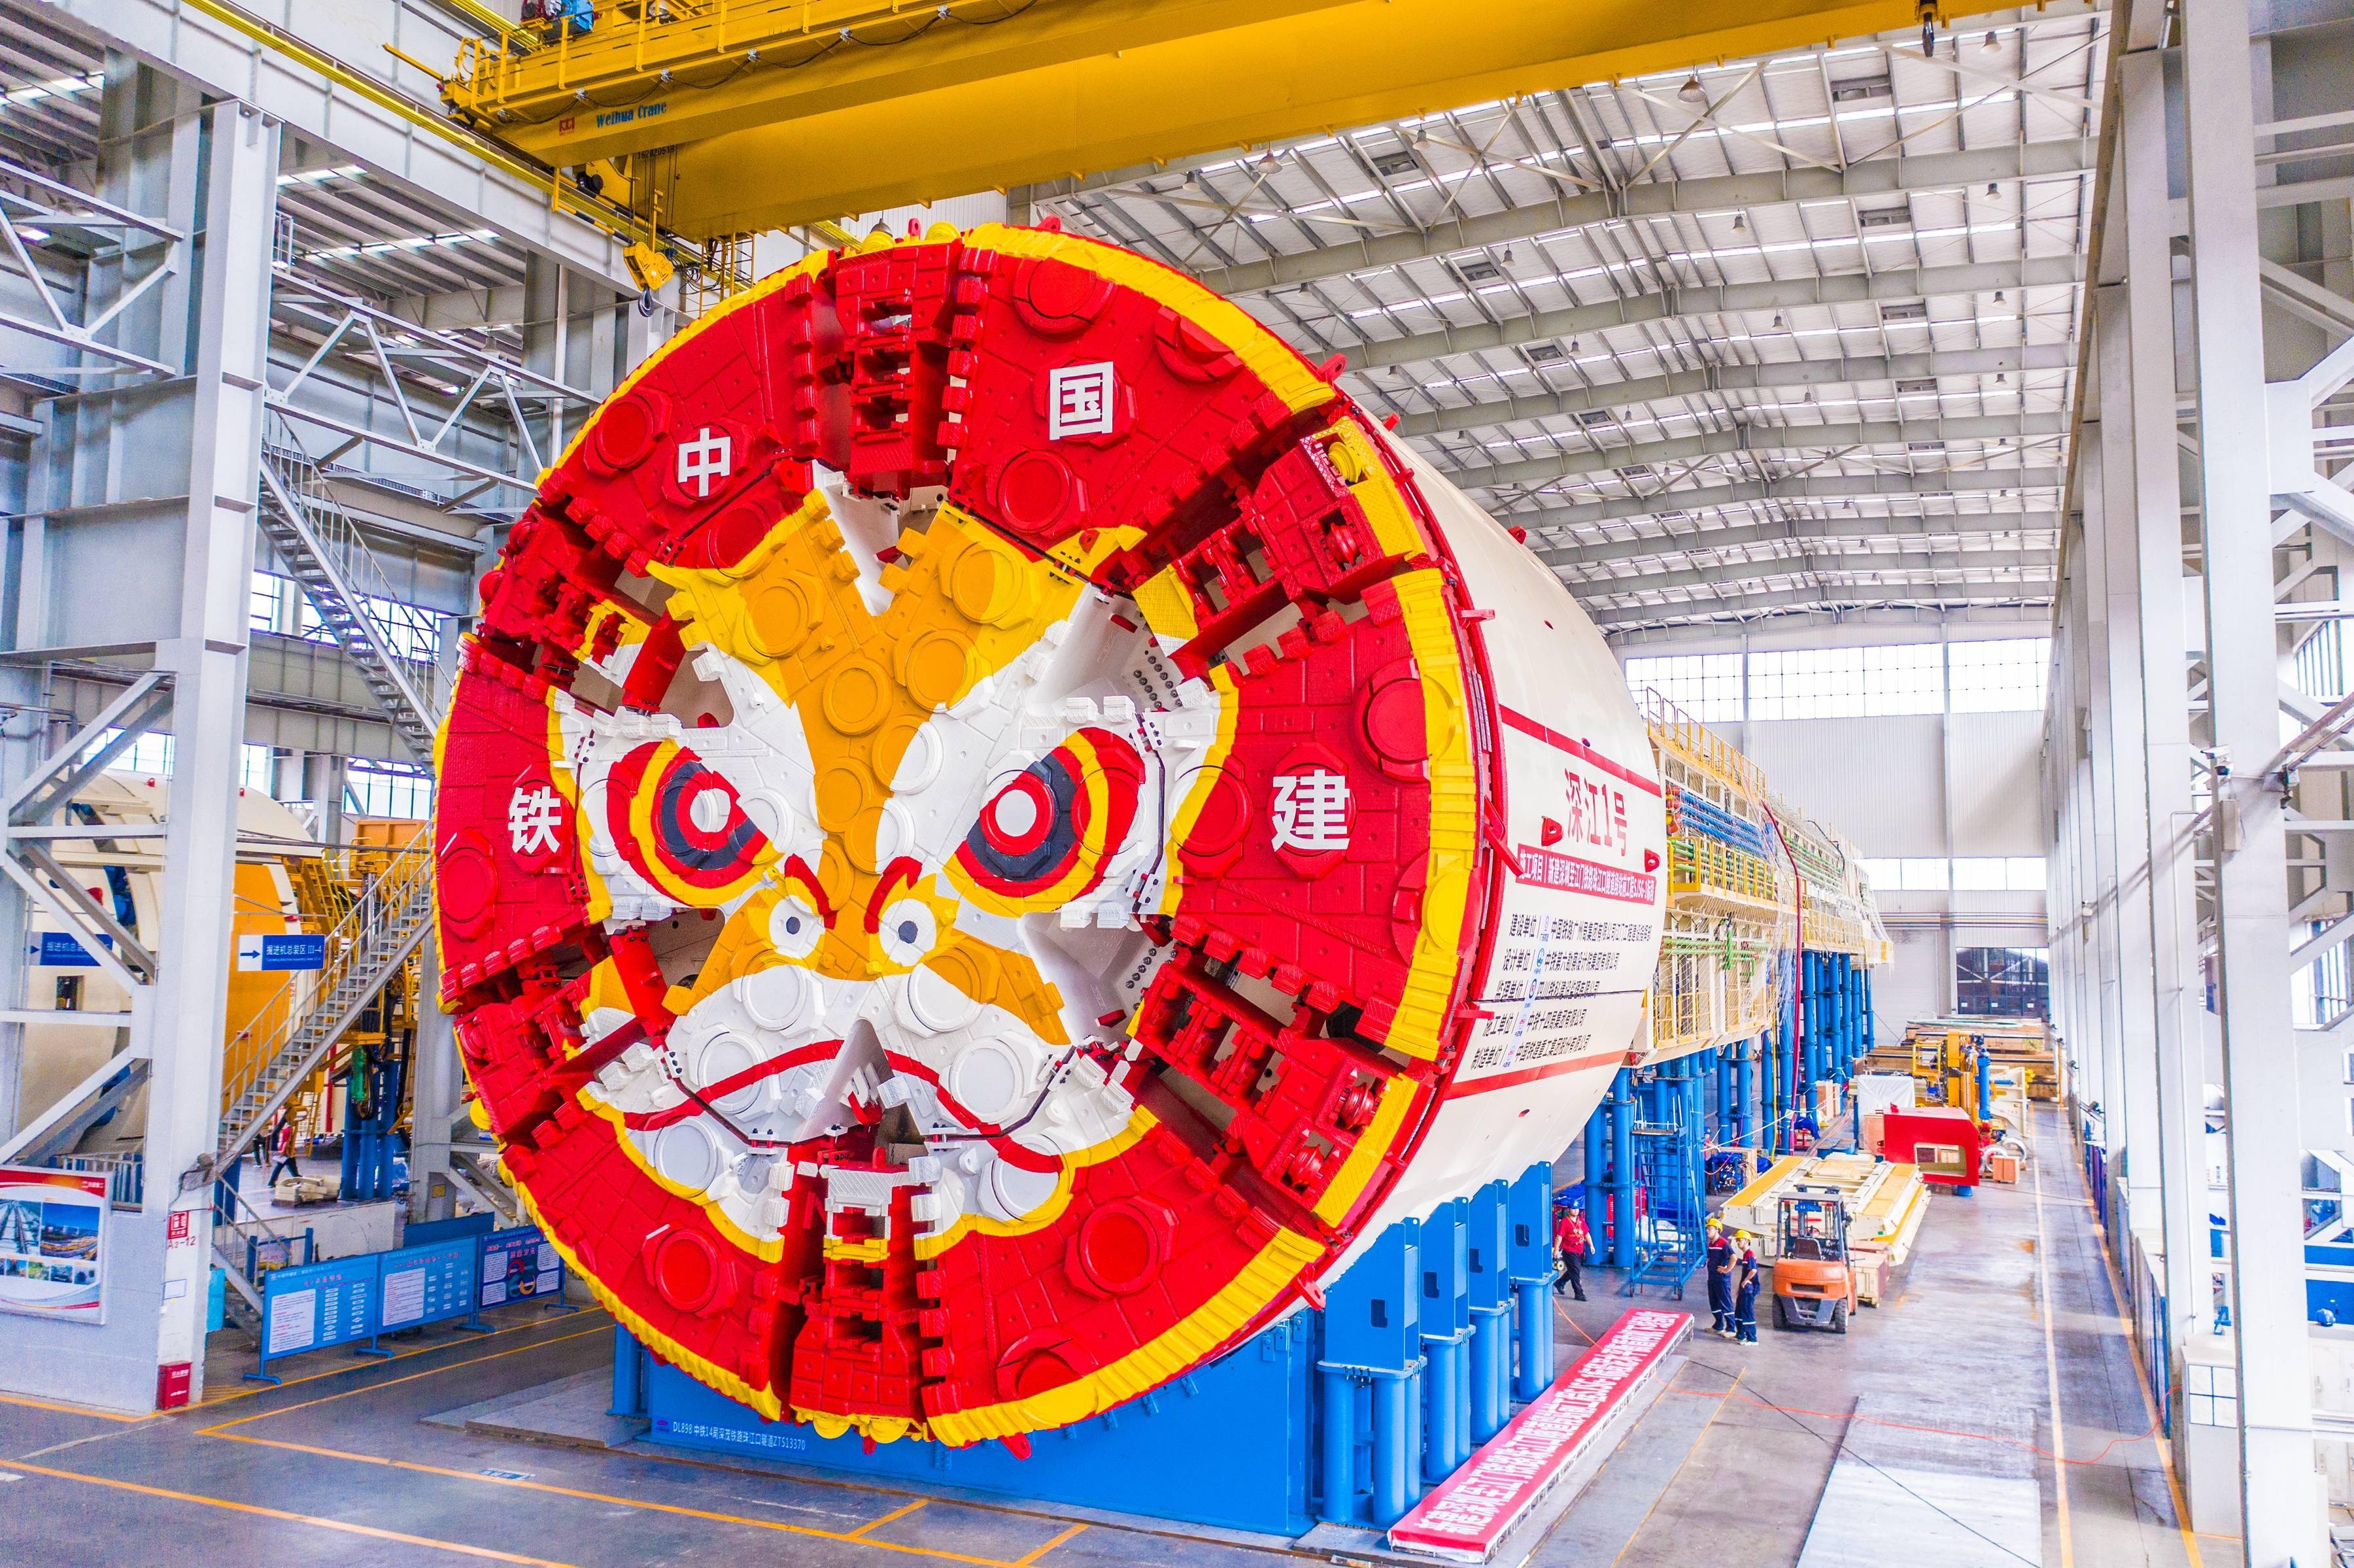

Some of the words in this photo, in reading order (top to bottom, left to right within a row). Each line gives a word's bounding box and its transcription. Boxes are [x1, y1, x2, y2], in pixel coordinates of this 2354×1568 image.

[596, 108, 634, 128] Weihua
[638, 101, 667, 119] Crane
[1049, 361, 1114, 440] 国
[678, 428, 730, 497] 中
[508, 786, 562, 854] 铁
[1271, 770, 1350, 852] 建
[1565, 768, 1627, 857] 深江1号
